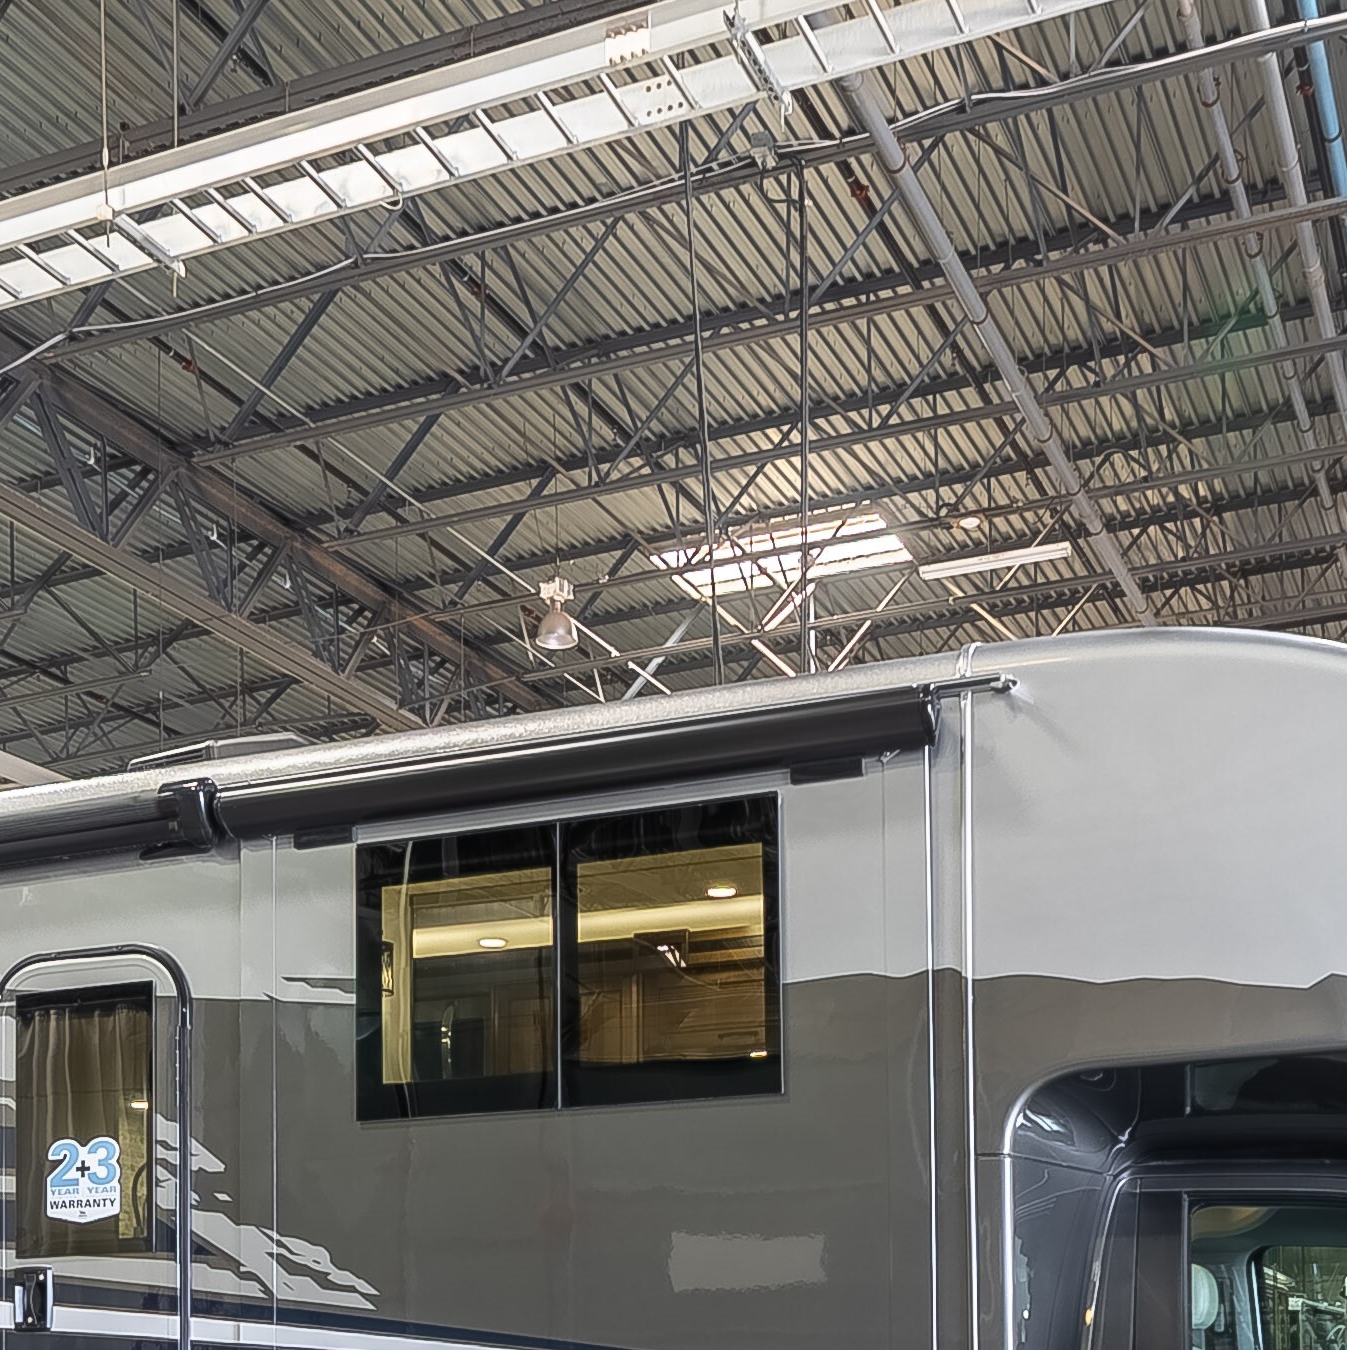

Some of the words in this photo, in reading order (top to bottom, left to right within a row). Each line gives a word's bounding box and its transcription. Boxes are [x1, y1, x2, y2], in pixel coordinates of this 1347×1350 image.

[50, 1188, 80, 1196] YEAR
[87, 1186, 117, 1194] YEAR
[49, 1198, 117, 1210] WARRANTY
